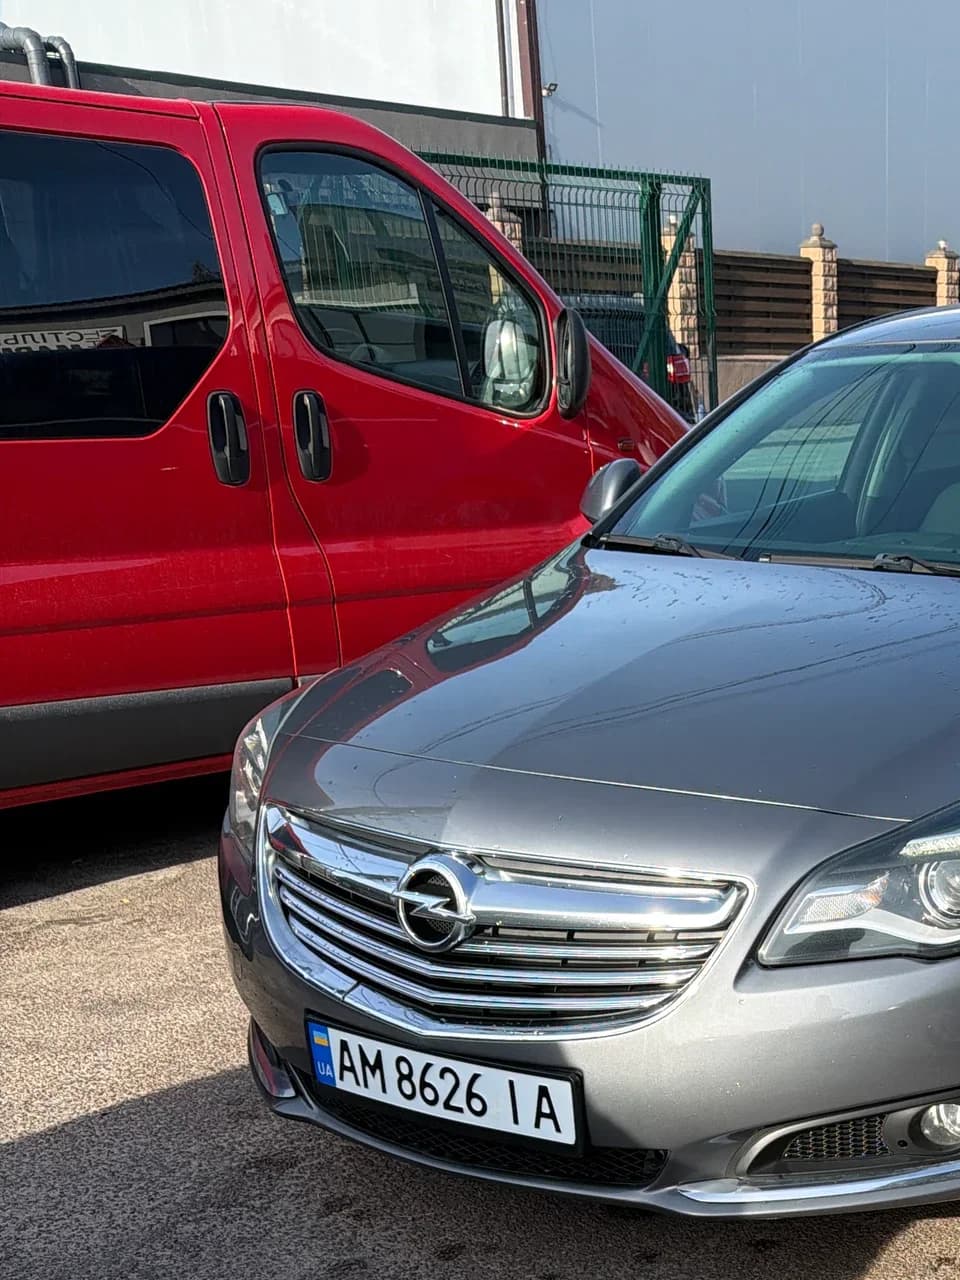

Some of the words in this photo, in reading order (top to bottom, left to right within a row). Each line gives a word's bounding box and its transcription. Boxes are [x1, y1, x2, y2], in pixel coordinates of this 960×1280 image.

[318, 1061, 333, 1078] UA
[339, 1039, 387, 1094] AM
[395, 1055, 488, 1118] 8626
